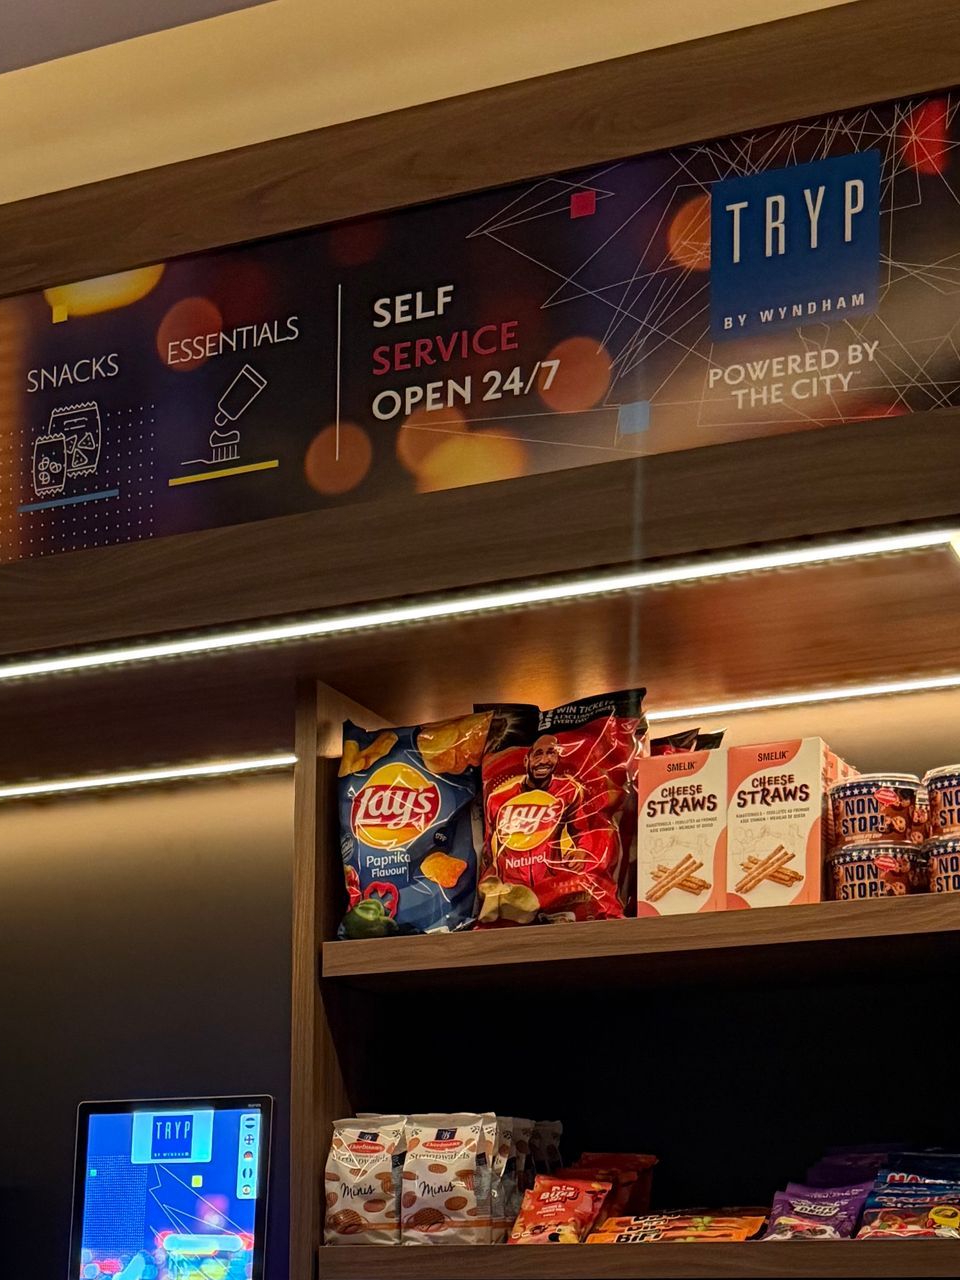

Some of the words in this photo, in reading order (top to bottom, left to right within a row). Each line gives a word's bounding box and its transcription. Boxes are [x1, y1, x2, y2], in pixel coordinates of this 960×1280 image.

[726, 178, 866, 264] TRYP
[372, 285, 455, 329] SELF
[723, 312, 748, 330] BY
[759, 293, 867, 323] WYNDHAM
[166, 316, 300, 366] ESSENTIALS
[371, 320, 520, 376] SERVICE
[26, 353, 120, 394] SNACKS
[708, 348, 839, 390] POWERED
[846, 340, 881, 364] BY
[371, 375, 472, 422] OPEN
[482, 359, 561, 407] 24/7
[731, 382, 785, 410] THE
[556, 704, 577, 715] WIN
[757, 750, 787, 762] SMELIK
[666, 761, 695, 774] SMELIK
[660, 784, 703, 797] CHEESE
[751, 774, 795, 789] CHEESE
[736, 784, 810, 809] STRAWS
[943, 790, 960, 807] NO
[355, 787, 433, 829] Lay's
[646, 794, 719, 818] STRAWS
[845, 798, 879, 816] NON
[499, 802, 561, 835] Lay's
[842, 815, 885, 834] STOP!
[940, 809, 960, 826] STO
[366, 852, 411, 869] Paprika
[505, 852, 546, 870] Naturel
[938, 857, 960, 873] NO
[371, 866, 408, 878] Flavour
[845, 864, 878, 881] NON
[841, 881, 884, 900] STOP!
[936, 875, 960, 892] STO
[155, 1121, 191, 1139] TRYP
[340, 1183, 376, 1199] Minis
[419, 1180, 455, 1197] Minis
